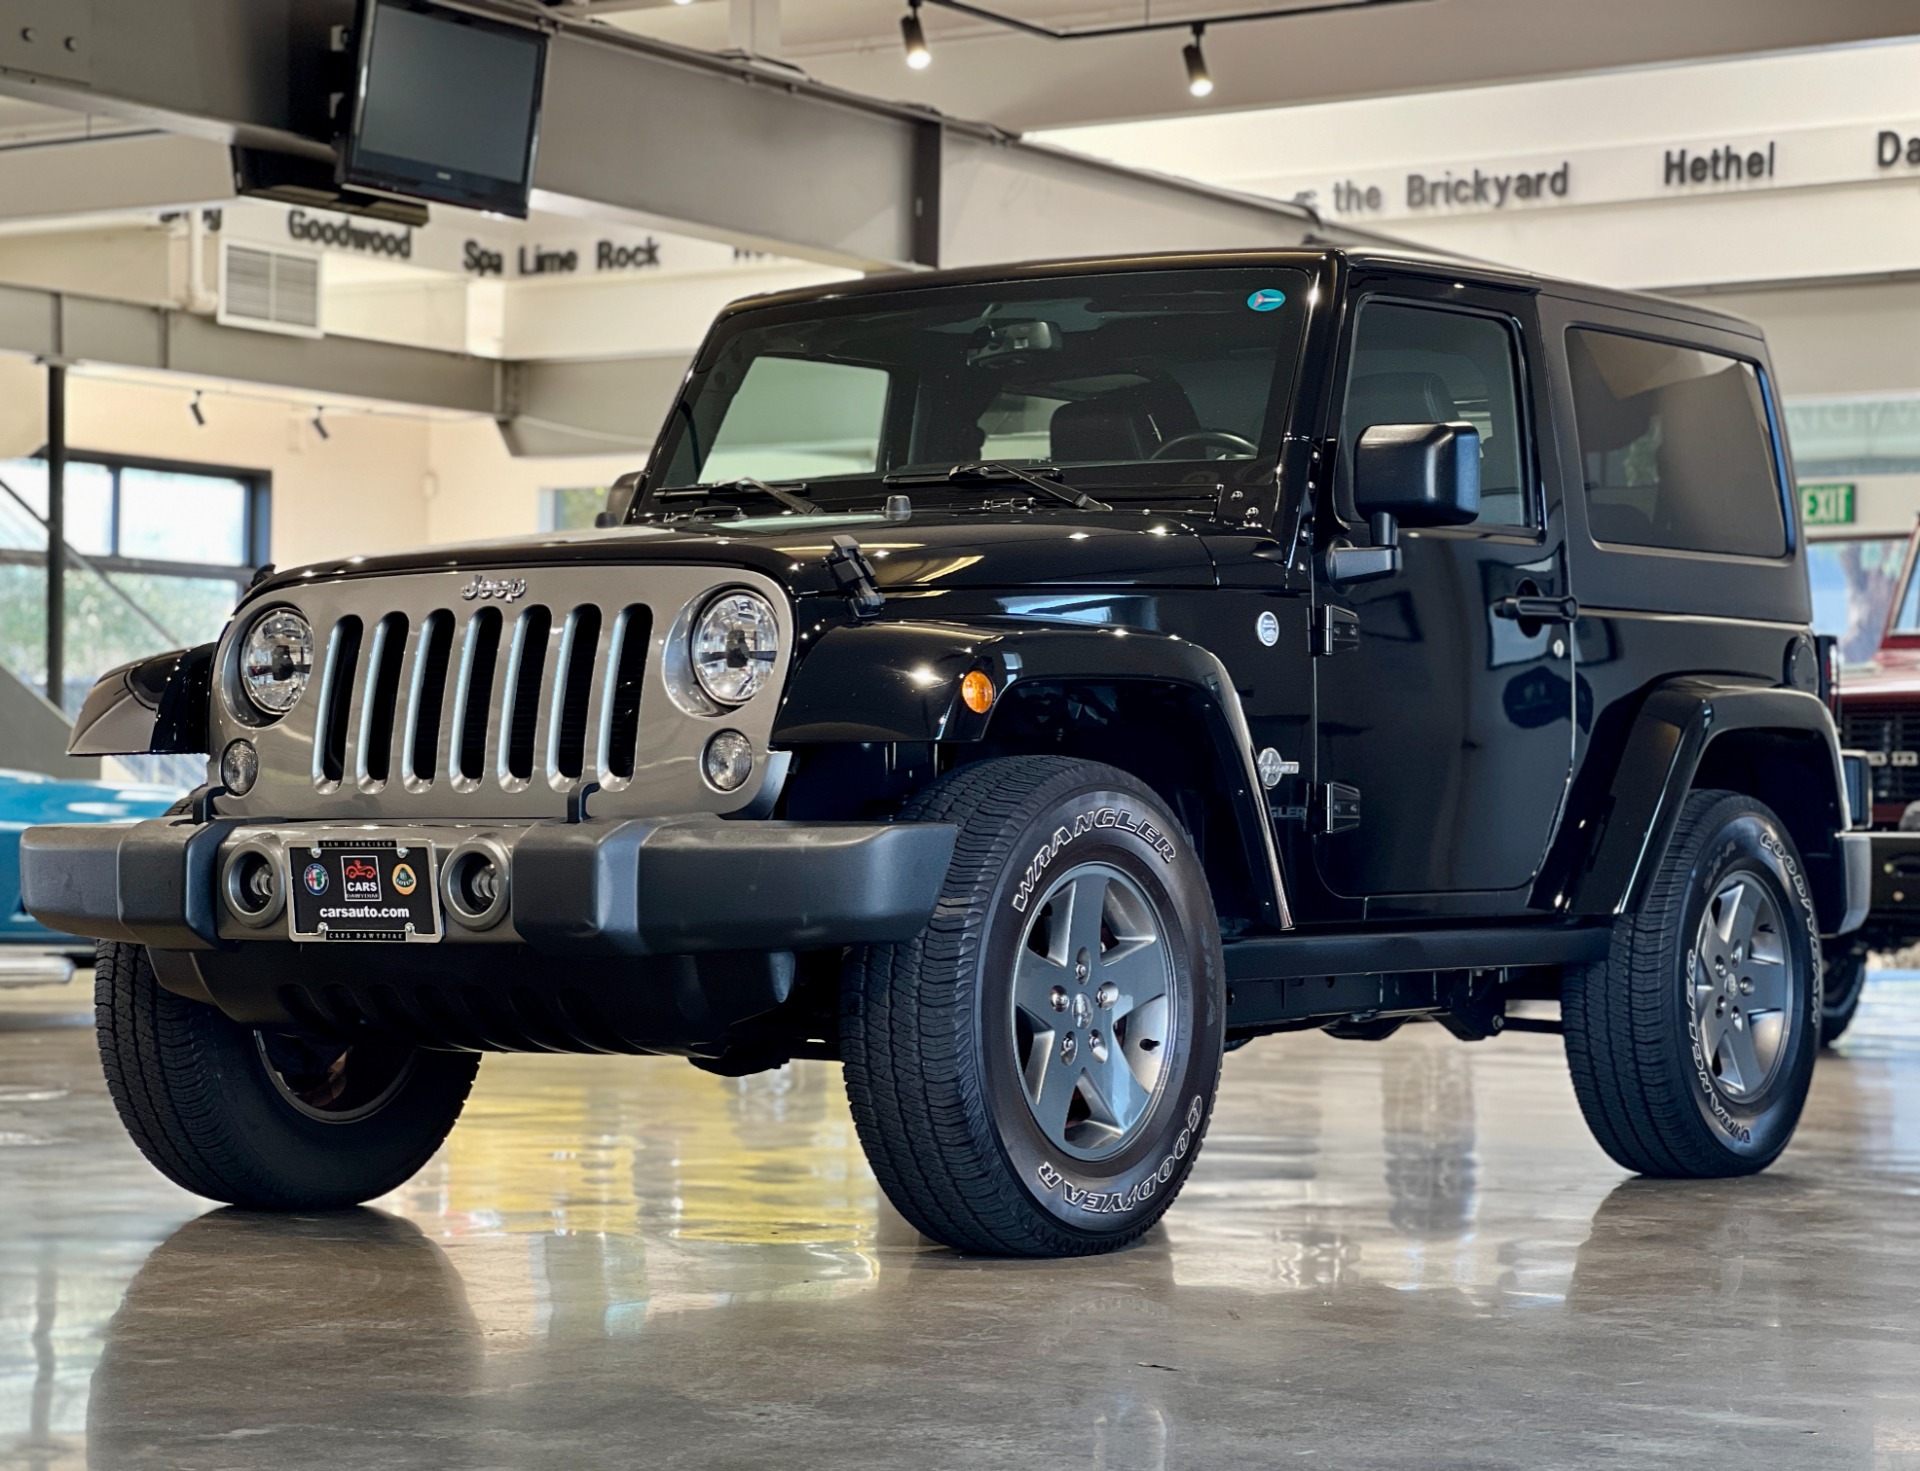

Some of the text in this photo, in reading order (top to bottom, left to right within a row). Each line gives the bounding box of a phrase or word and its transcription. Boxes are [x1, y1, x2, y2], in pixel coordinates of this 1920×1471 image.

[1664, 141, 1775, 186] Hethel
[1333, 179, 1381, 212] the
[1406, 162, 1569, 210] Brickyard
[288, 208, 411, 258] Goodwood
[463, 239, 504, 276] Spa
[519, 237, 660, 275] Lime Rock
[1801, 487, 1851, 521] EXIT
[461, 574, 527, 603] Jeep
[1012, 807, 1177, 914] WRANGLER
[347, 882, 377, 892] CARS
[319, 905, 410, 918] carsauto.com
[1759, 832, 1822, 1026] GOODYEAR
[1687, 949, 1752, 1144] WRANGLER
[1037, 1094, 1203, 1214] GOODYEAR
